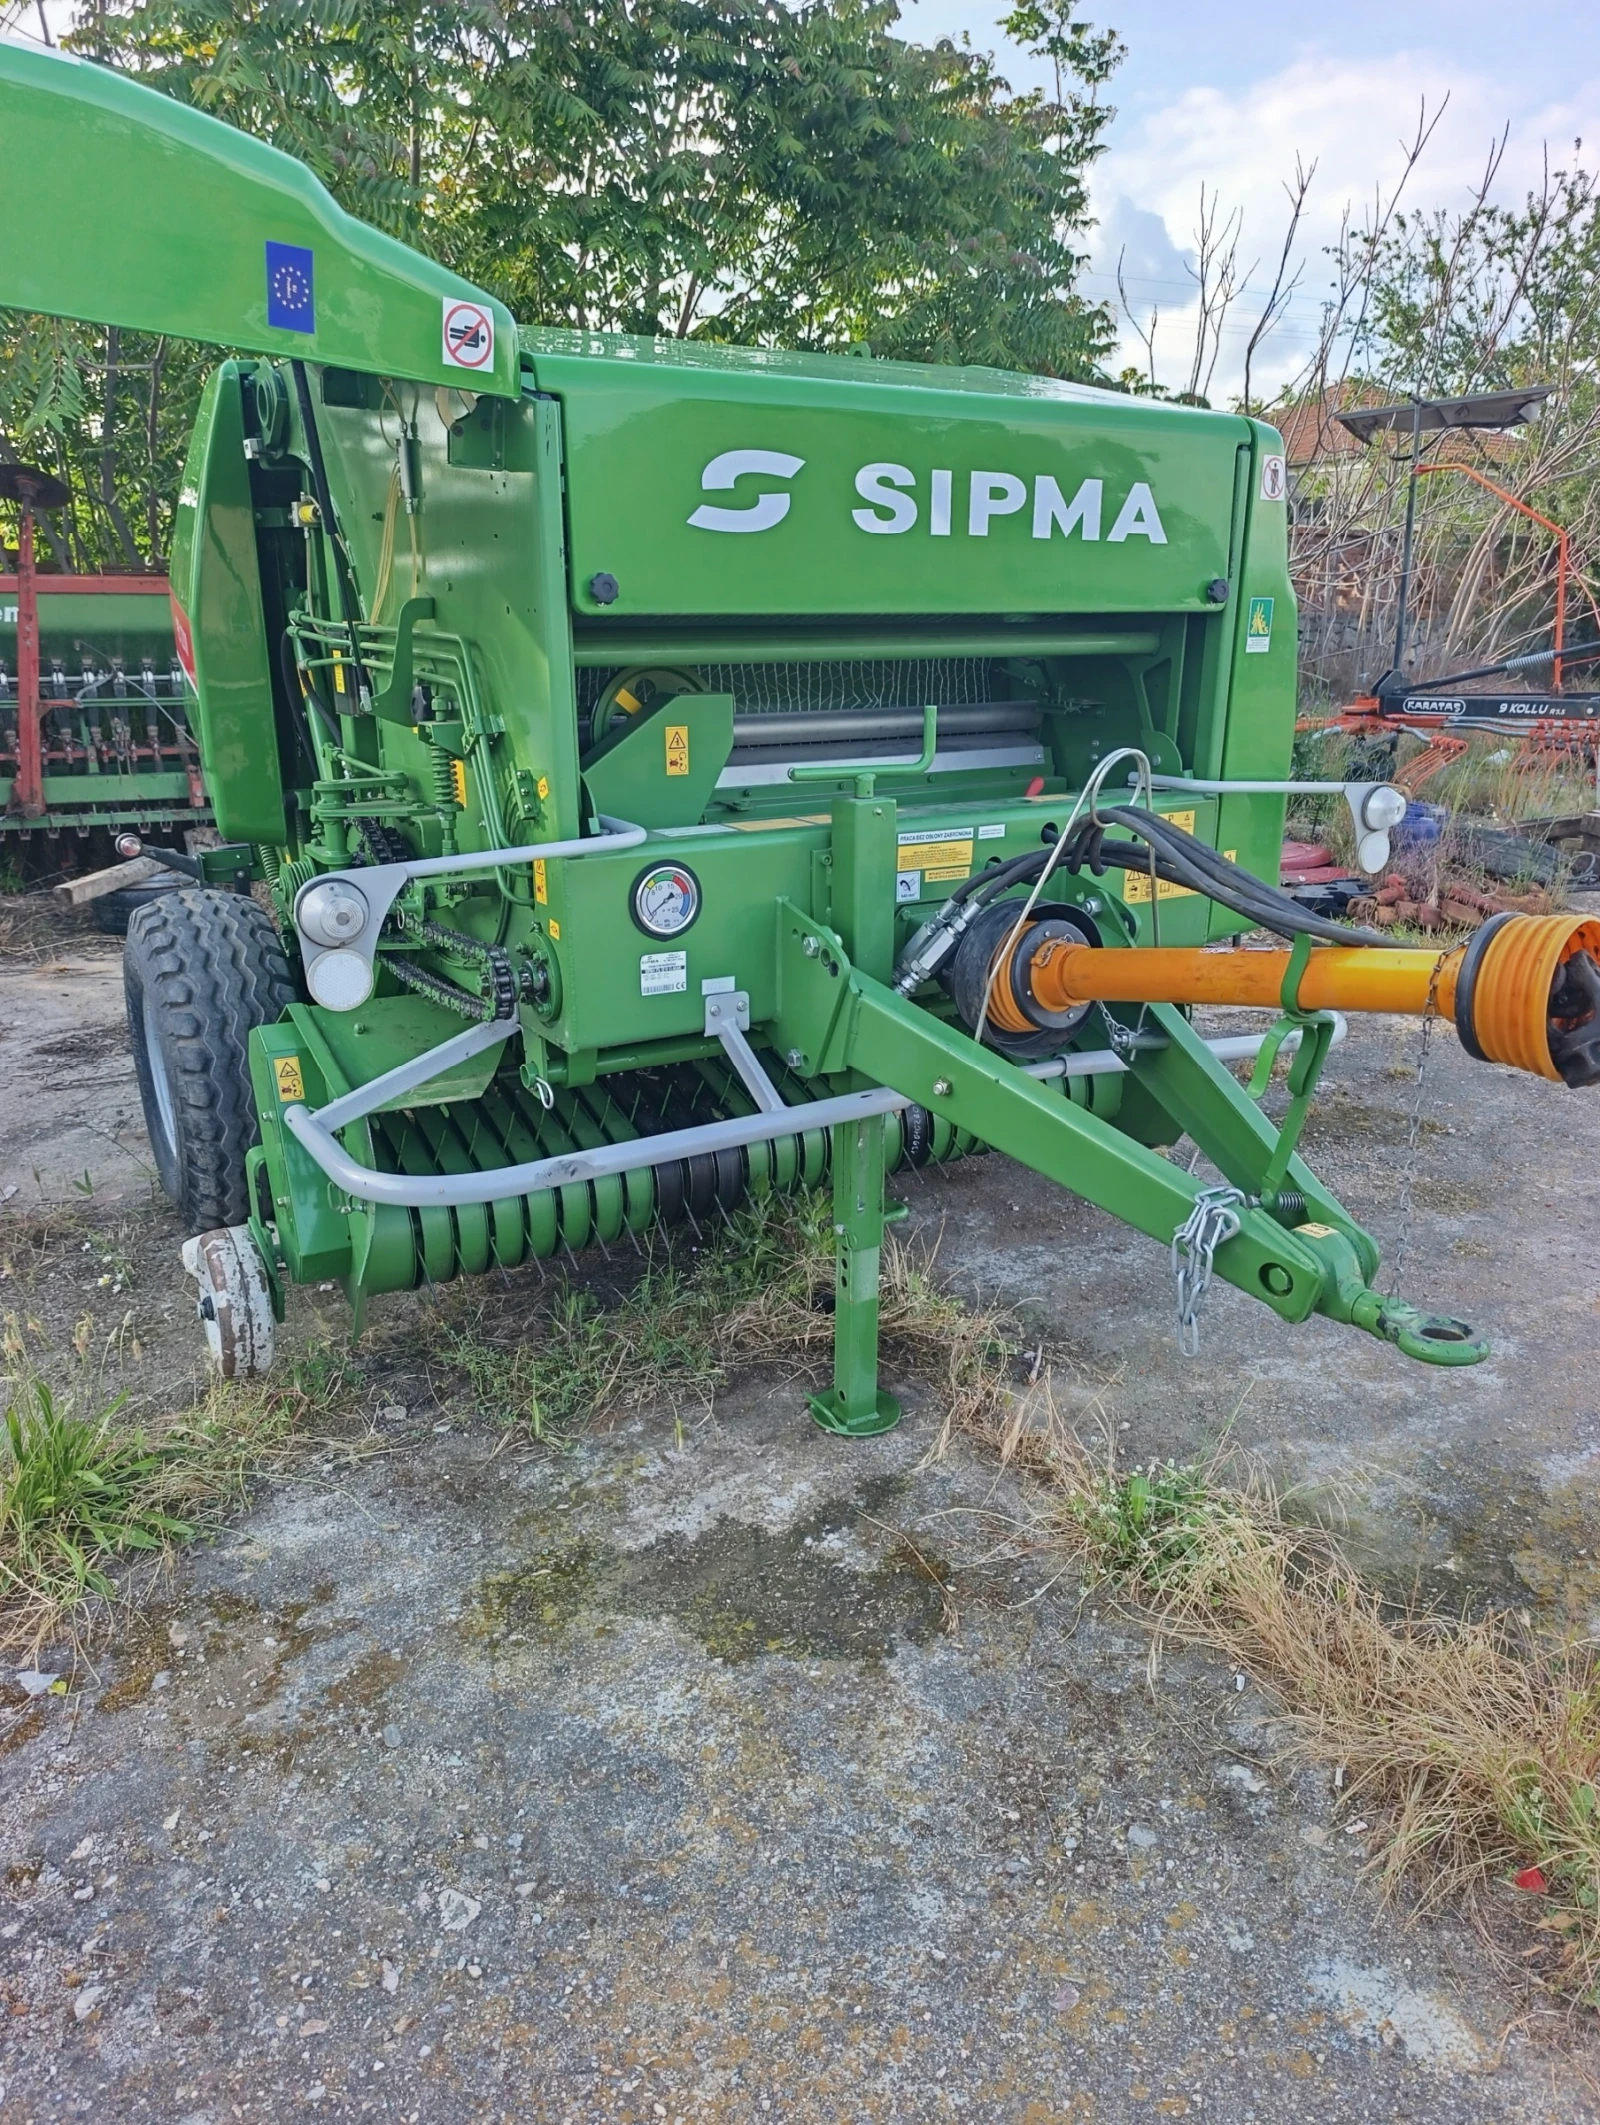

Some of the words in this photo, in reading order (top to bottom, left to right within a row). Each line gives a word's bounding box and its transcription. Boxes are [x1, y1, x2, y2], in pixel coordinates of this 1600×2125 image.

[852, 462, 1168, 544] SIPMA
[1499, 703, 1508, 713] 9
[1509, 703, 1549, 714] KOLLU
[655, 884, 662, 892] 10
[674, 892, 682, 900] 20
